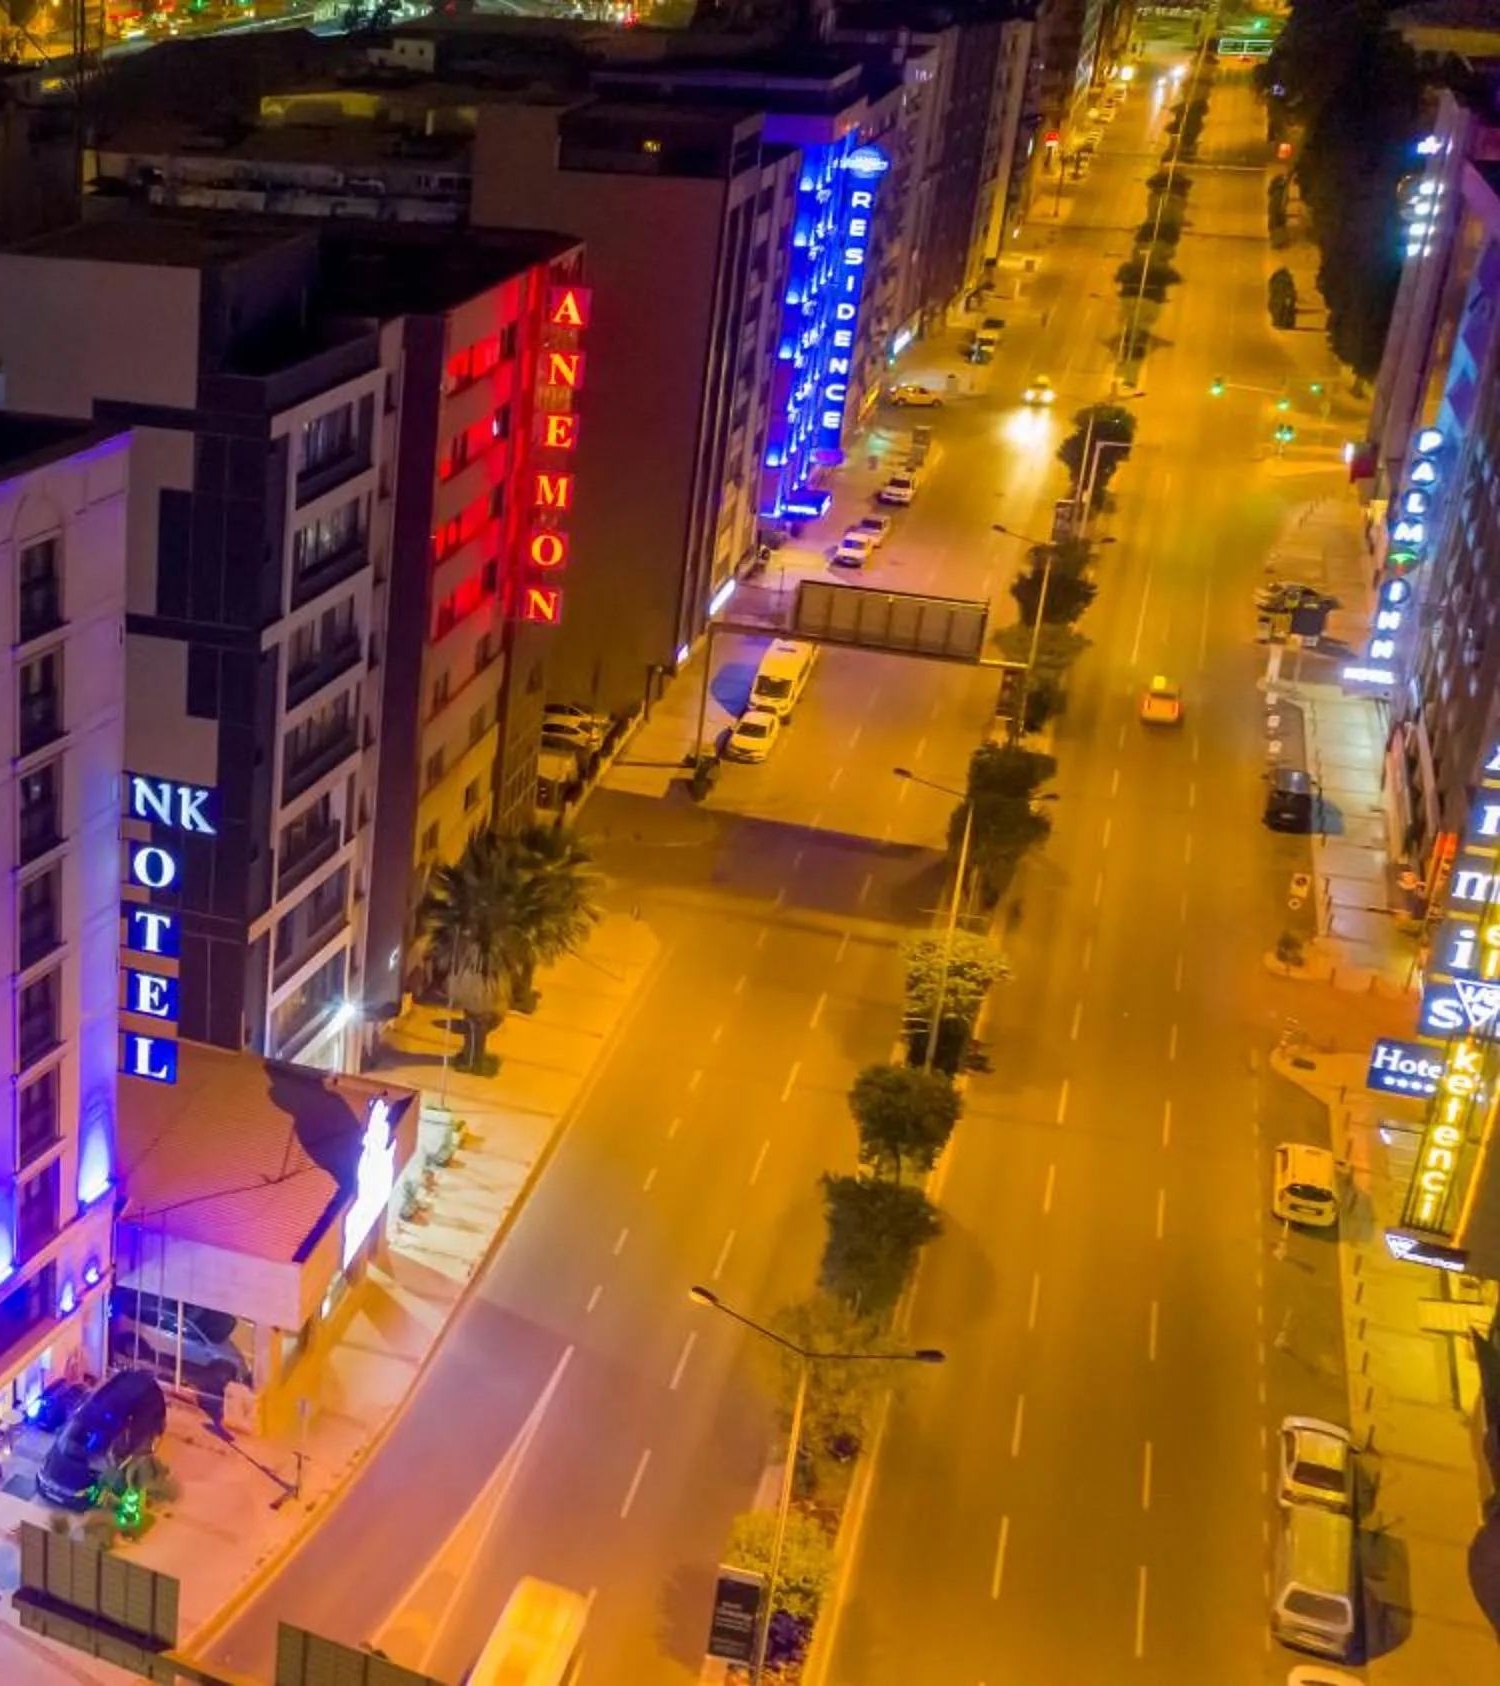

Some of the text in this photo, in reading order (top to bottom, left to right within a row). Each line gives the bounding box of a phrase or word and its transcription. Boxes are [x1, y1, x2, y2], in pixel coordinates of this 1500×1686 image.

[822, 190, 873, 430] RESIDENCE
[526, 290, 583, 621] ANEMON
[1393, 430, 1443, 543] PALM
[132, 777, 218, 834] NK
[132, 847, 176, 1079] OTEL
[1371, 1045, 1444, 1081] Hote
